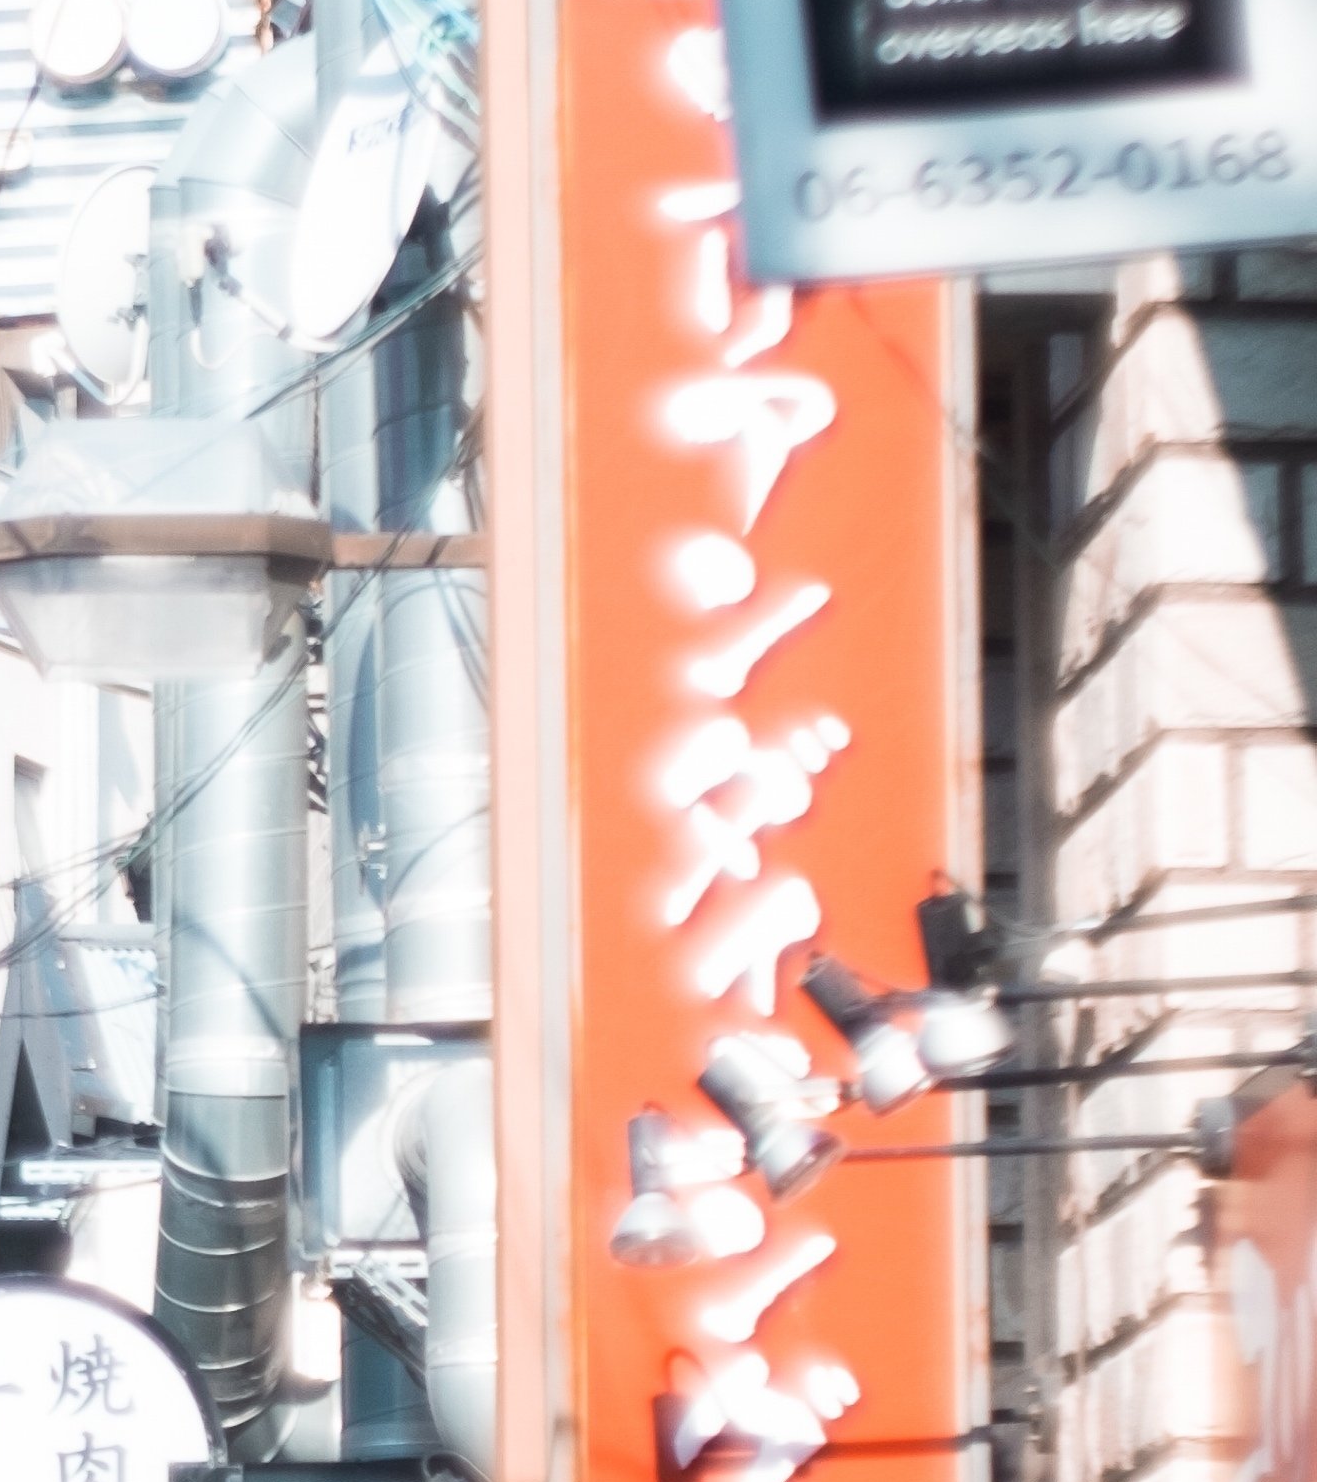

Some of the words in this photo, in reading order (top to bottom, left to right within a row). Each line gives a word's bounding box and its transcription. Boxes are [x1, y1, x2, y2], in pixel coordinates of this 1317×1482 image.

[875, 18, 1075, 66] overseas
[1078, 0, 1191, 47] here
[794, 128, 1293, 222] 06-6352-0168
